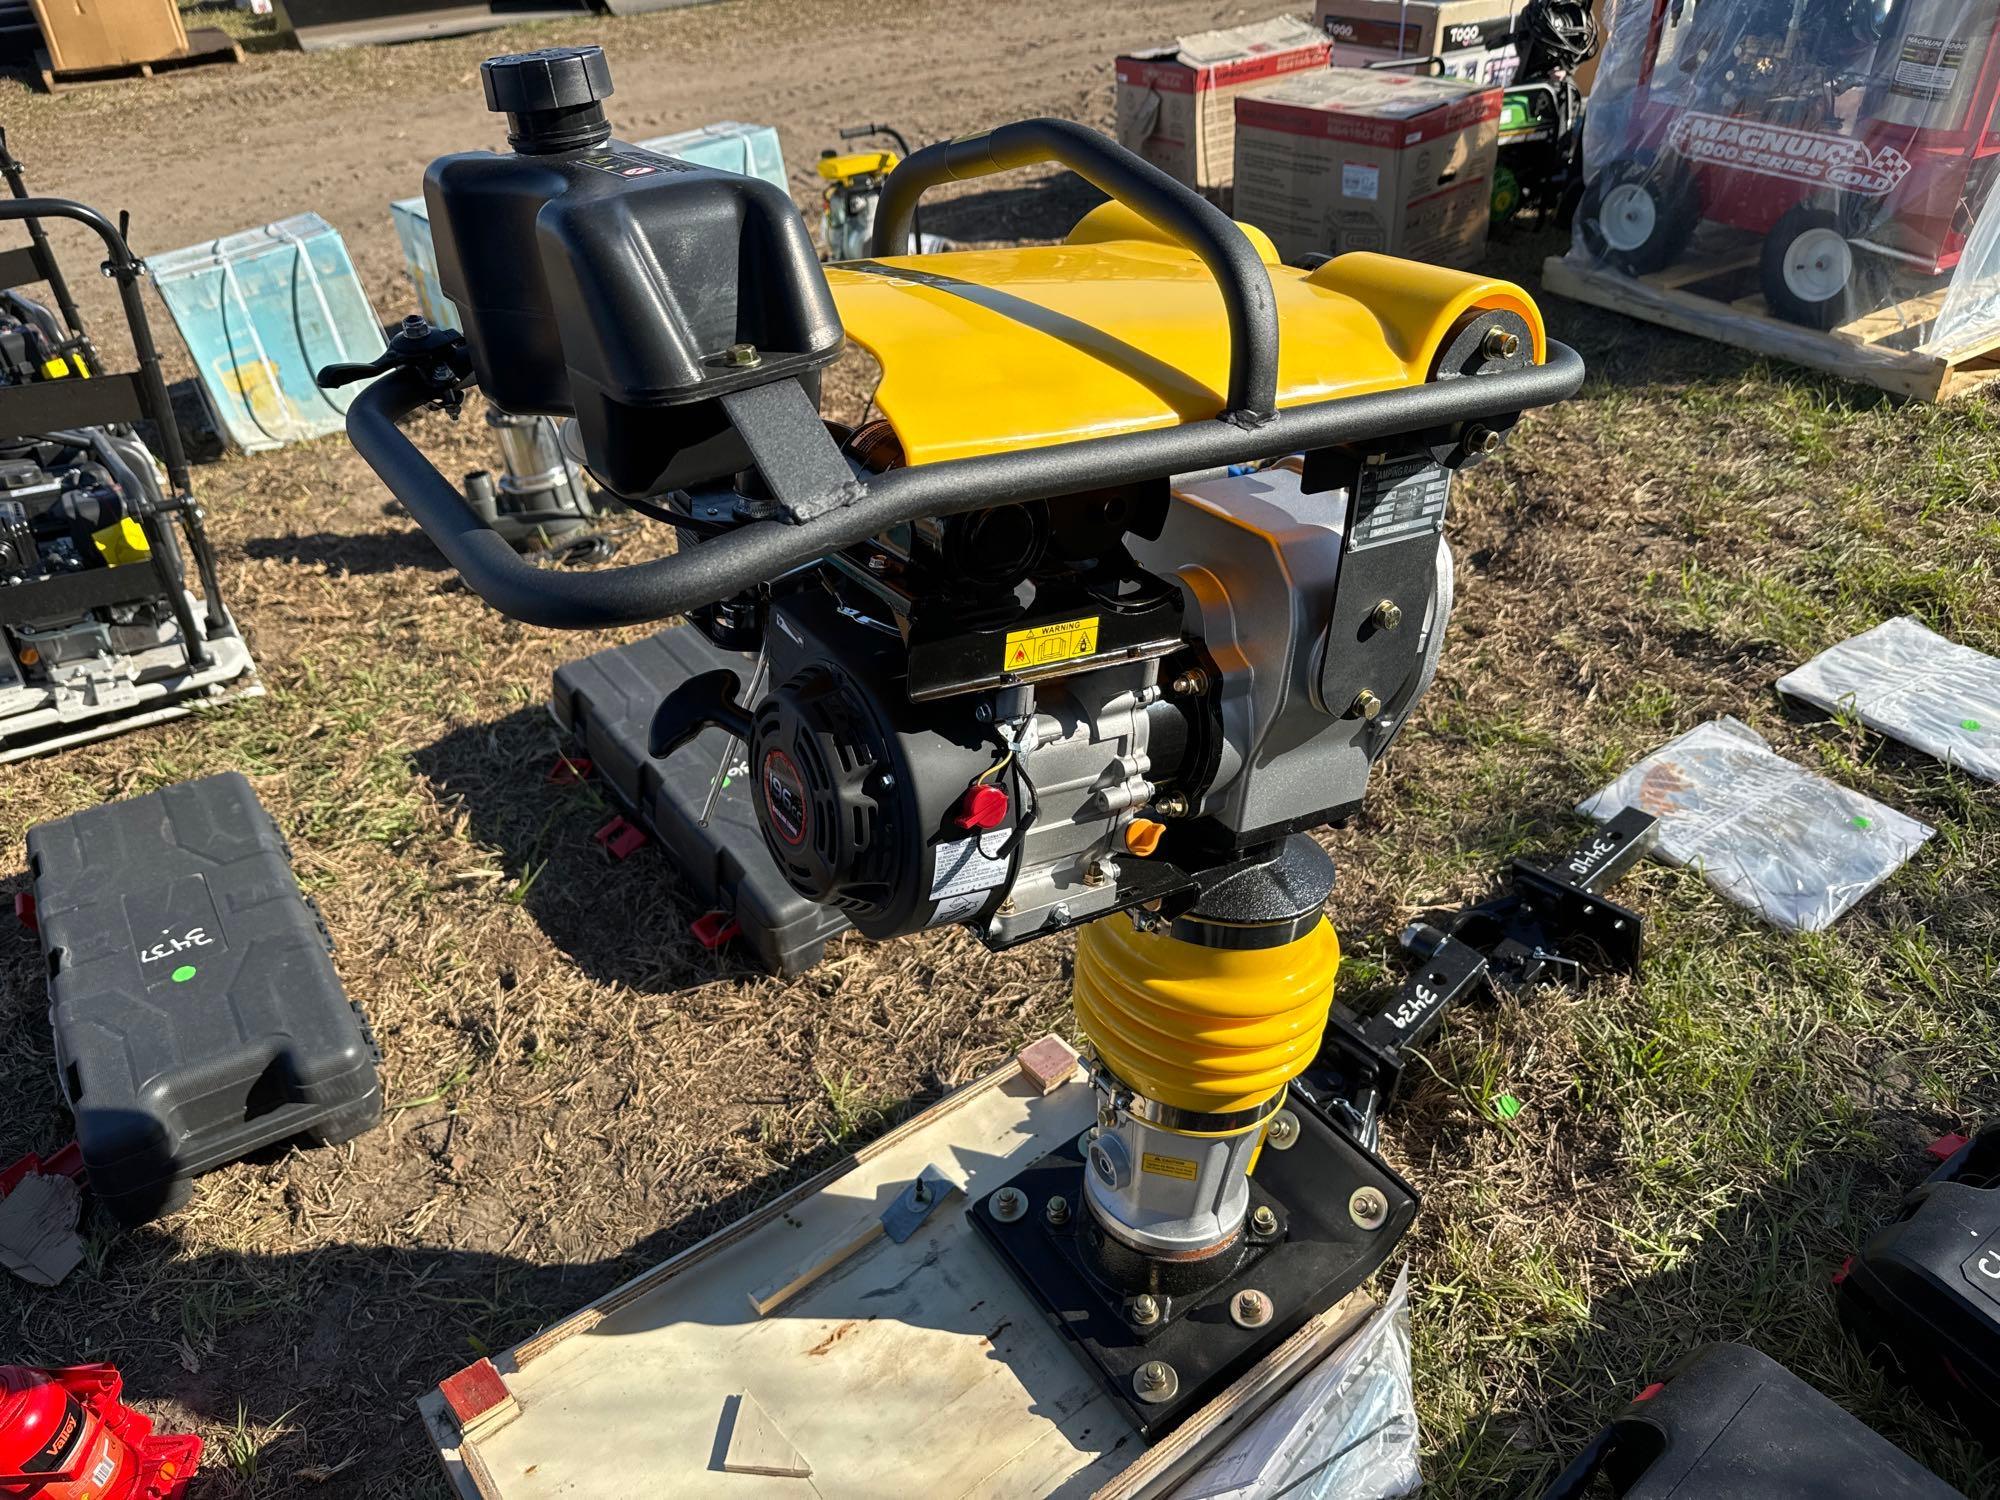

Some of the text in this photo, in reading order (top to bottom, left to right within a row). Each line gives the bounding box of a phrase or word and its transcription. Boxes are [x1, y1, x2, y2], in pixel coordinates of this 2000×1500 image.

[1690, 118, 1842, 164] MAGNUM
[1739, 151, 1825, 177] SERIES
[1829, 169, 1890, 190] GOLD
[1041, 622, 1081, 635] WARNING
[1569, 838, 1616, 875] 3440
[141, 927, 213, 963] 3437
[1384, 984, 1439, 1029] 3439
[46, 1412, 77, 1456] Valley
